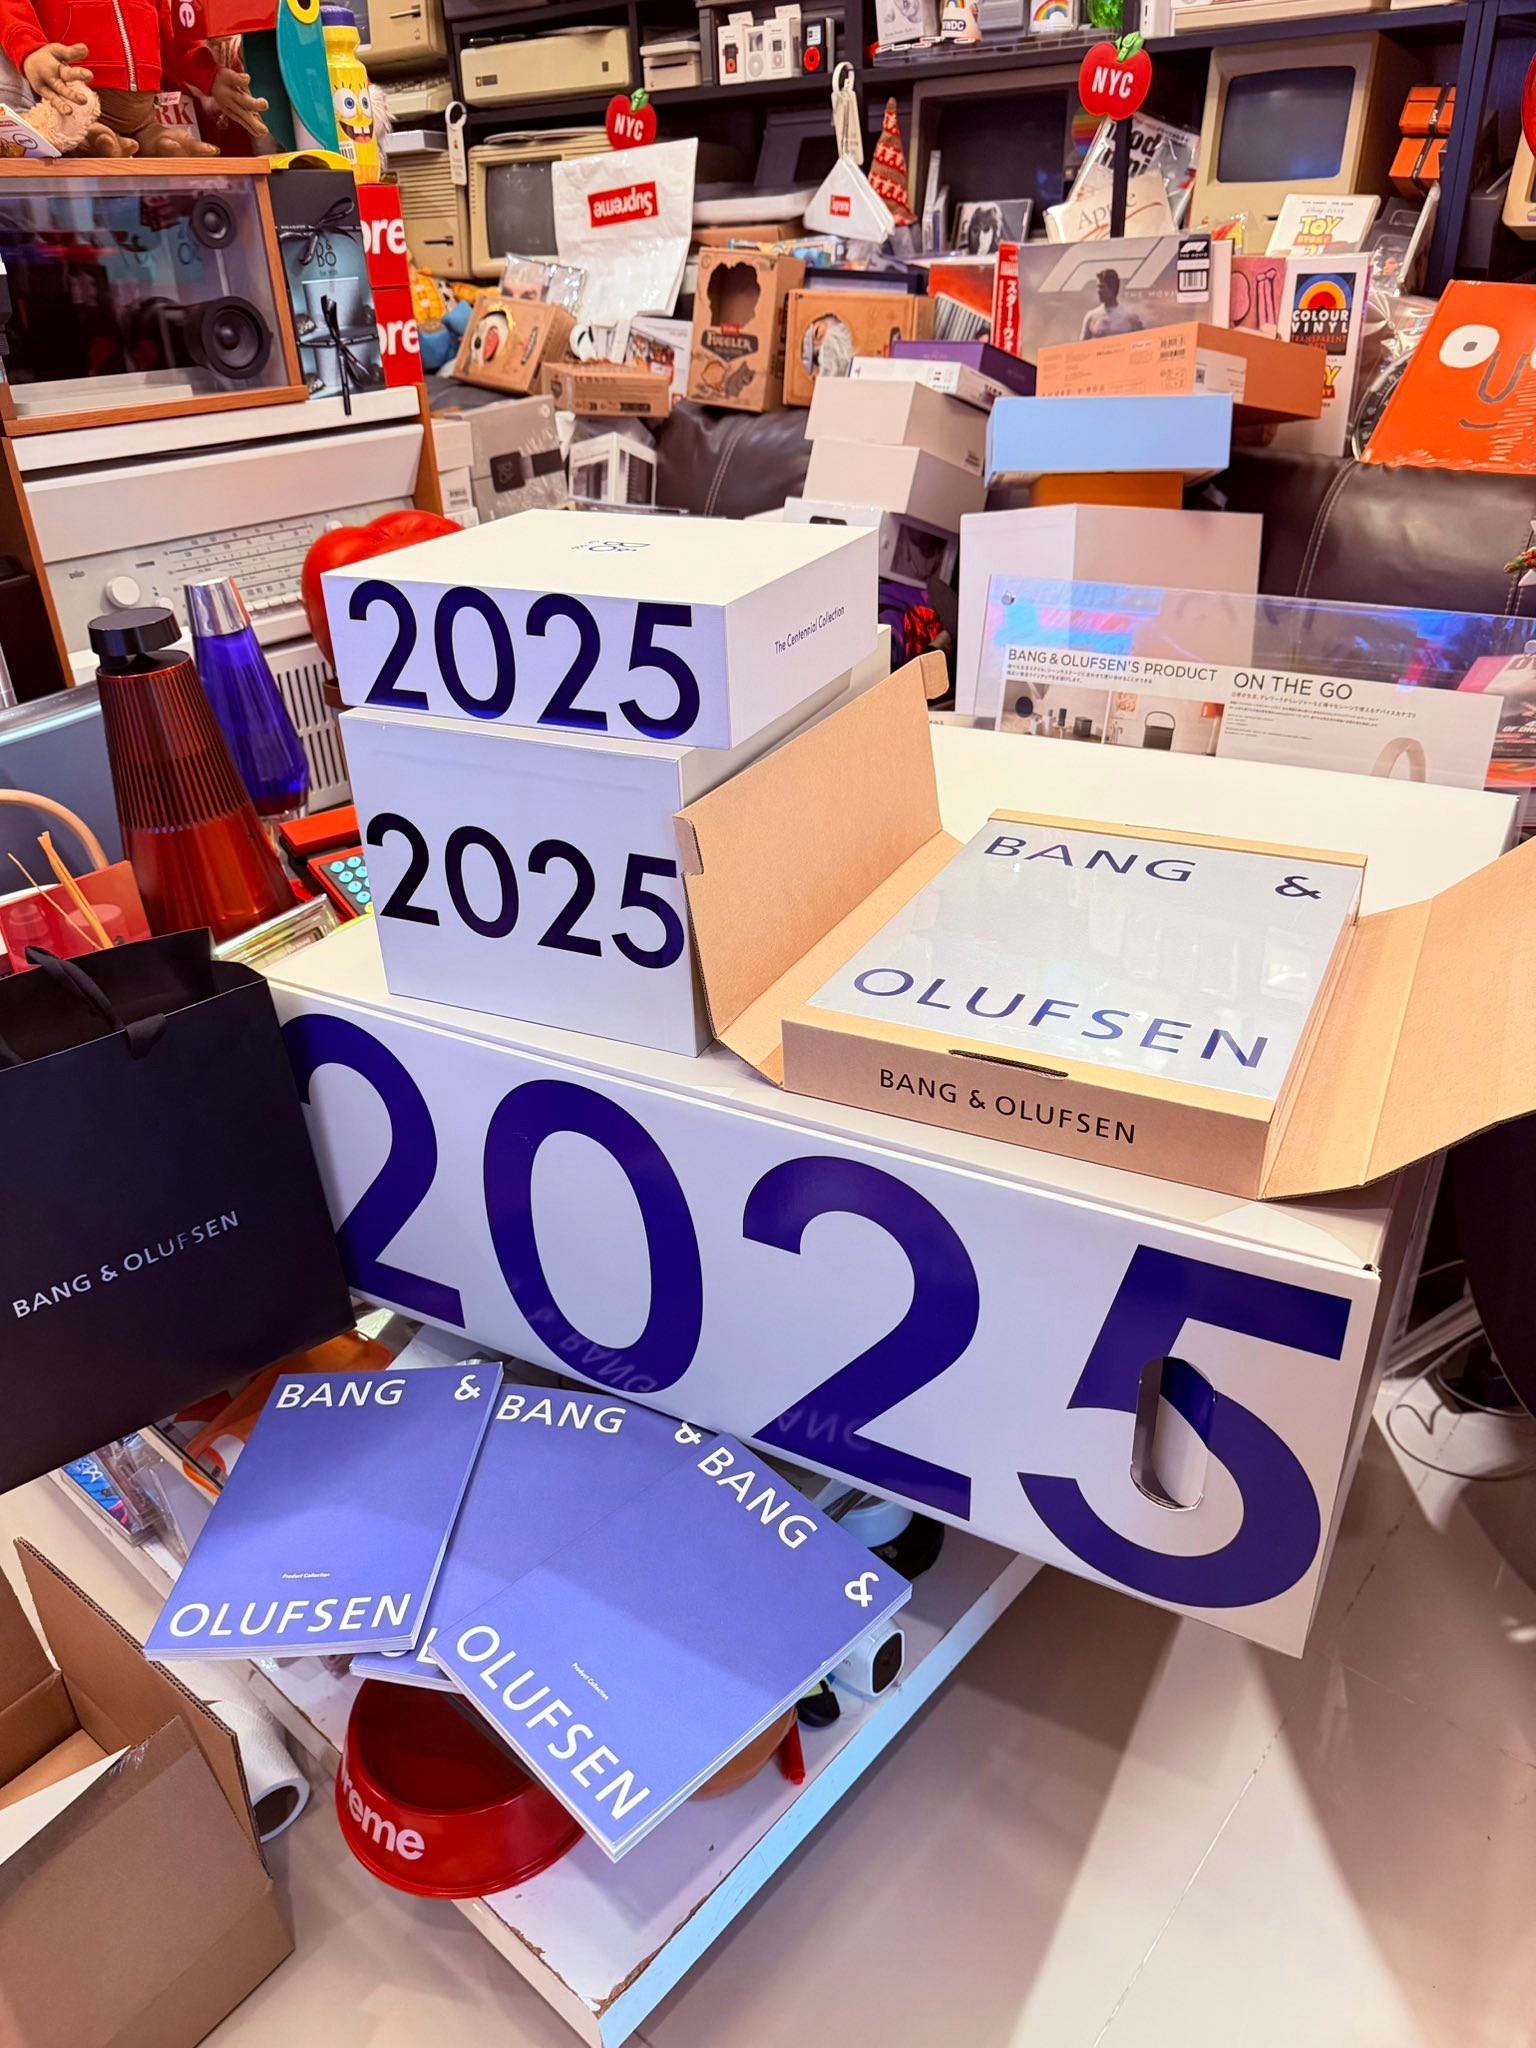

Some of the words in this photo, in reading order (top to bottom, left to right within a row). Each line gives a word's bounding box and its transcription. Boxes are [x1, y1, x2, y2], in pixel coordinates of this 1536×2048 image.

[1091, 66, 1135, 99] NYC
[614, 112, 645, 142] NYC
[593, 186, 653, 219] Supreme
[1300, 215, 1344, 236] TOY
[1148, 290, 1178, 298] MOVI
[1292, 309, 1349, 322] COLOUR
[1291, 322, 1348, 334] VINYL
[774, 639, 787, 655] The
[786, 617, 818, 648] Centennial
[818, 606, 845, 629] Collection
[349, 579, 700, 740] 2025
[1008, 648, 1047, 664] BANG
[1049, 652, 1058, 665] &
[1060, 654, 1140, 674] OLUFSEN'S
[1144, 662, 1218, 682] PRODUCT
[1233, 672, 1265, 691] ON
[1271, 676, 1313, 696] THE
[1319, 681, 1353, 700] GO
[984, 835, 1198, 883] BANG
[1274, 875, 1322, 900] &
[366, 812, 685, 970] 2025
[853, 967, 1269, 1069] OLUFSEN
[880, 1068, 957, 1104] BANG
[969, 1089, 987, 1110] &
[995, 1095, 1136, 1145] OLUFSEN
[12, 1273, 92, 1319] BANG
[100, 1264, 119, 1283] &
[123, 1210, 239, 1273] OLUFSEN
[280, 1013, 1351, 1609] 2025
[276, 1378, 406, 1409] BANG
[454, 1374, 481, 1401] &
[495, 1394, 627, 1434] BANG
[674, 1421, 702, 1445] &
[697, 1446, 818, 1550] BANG
[844, 1571, 880, 1608] &
[169, 1593, 412, 1638] OLUFSEN
[571, 1662, 590, 1680] Product
[587, 1678, 609, 1701] Collection
[456, 1625, 652, 1822] OLUFSEN
